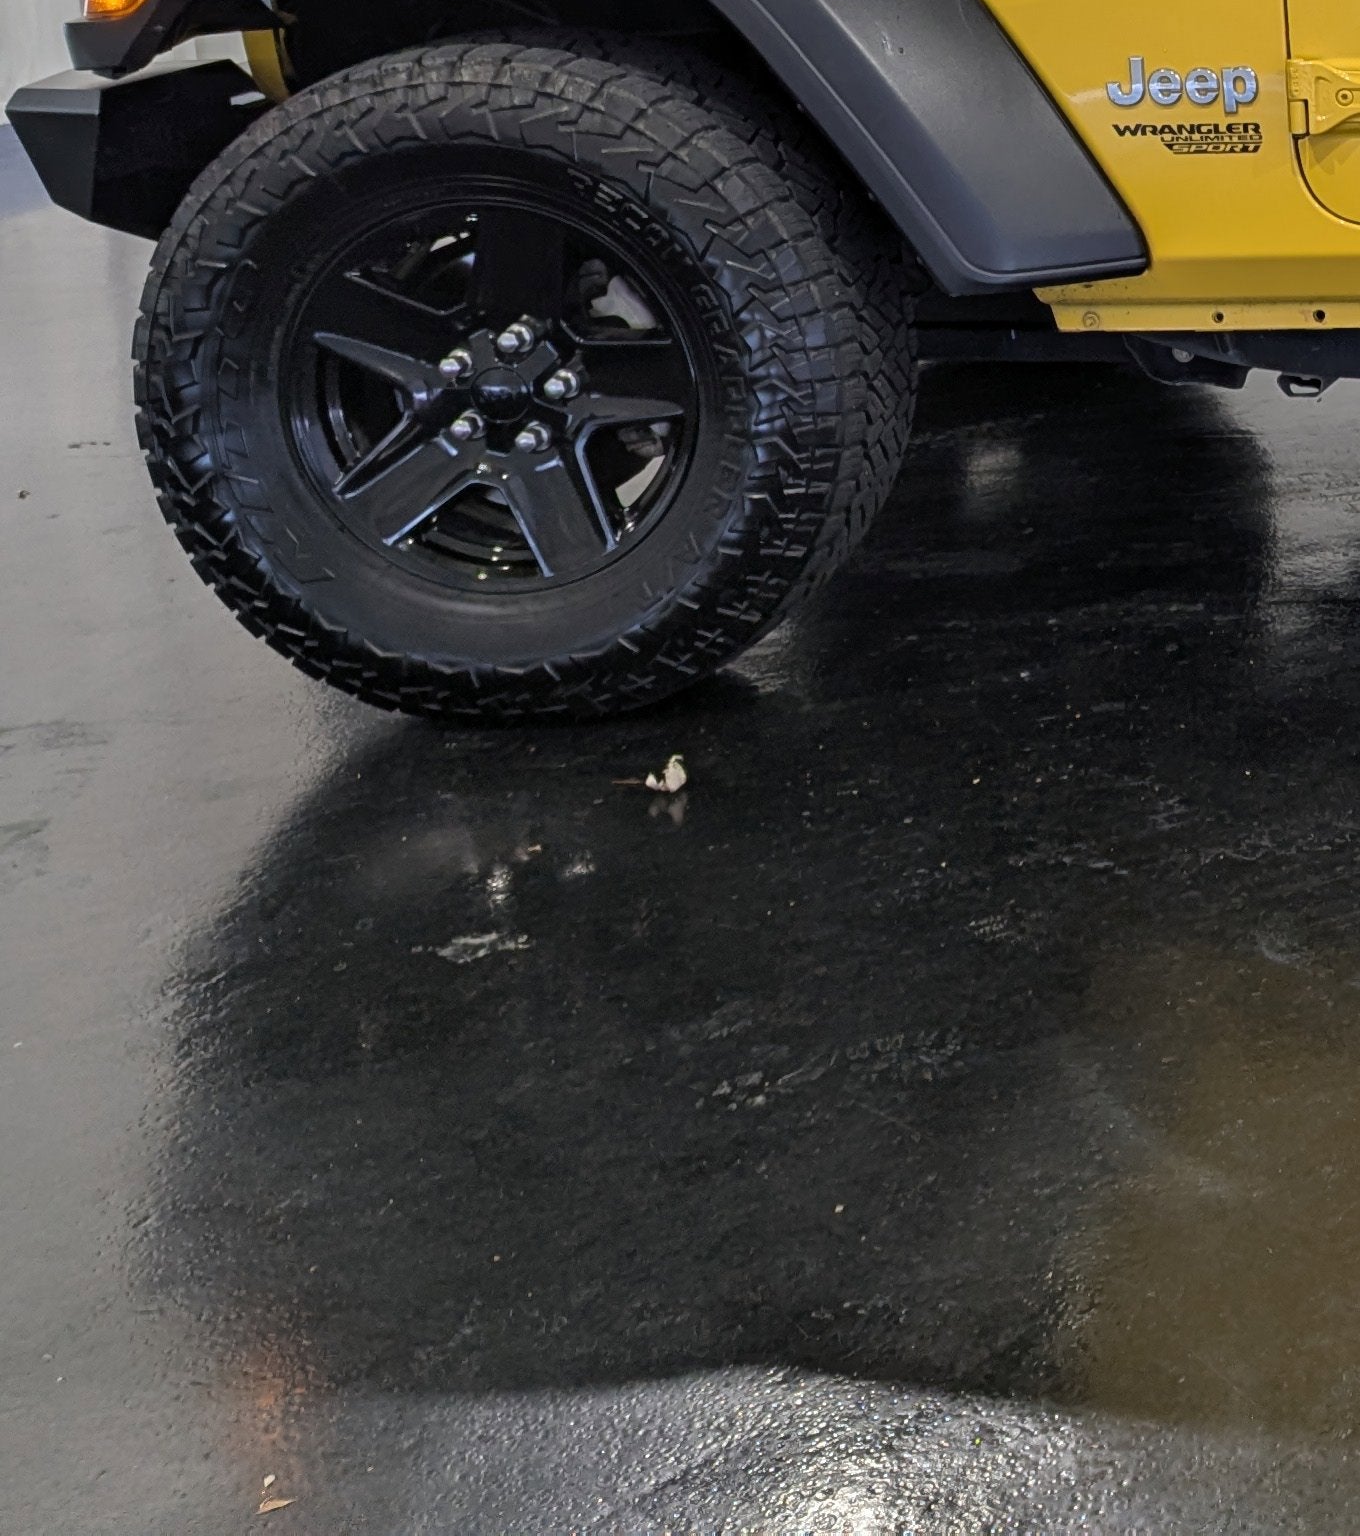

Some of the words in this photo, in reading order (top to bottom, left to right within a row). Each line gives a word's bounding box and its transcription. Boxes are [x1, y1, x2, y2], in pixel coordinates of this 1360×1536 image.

[1106, 56, 1259, 115] Jeep
[1112, 123, 1261, 137] WRANGLER
[1171, 143, 1261, 153] SPORT
